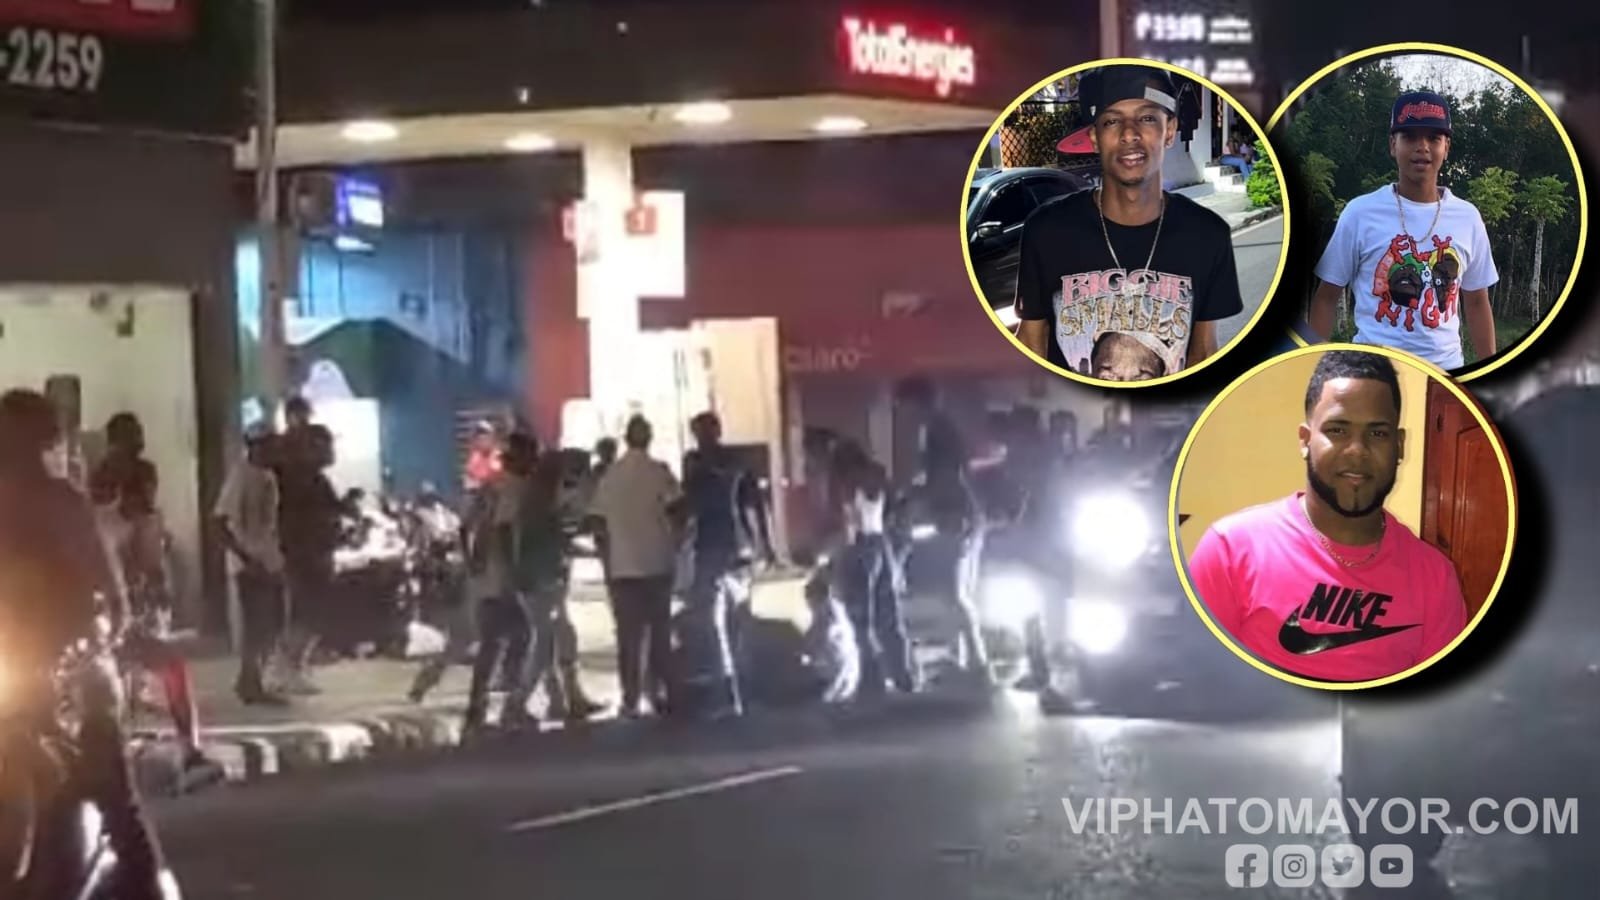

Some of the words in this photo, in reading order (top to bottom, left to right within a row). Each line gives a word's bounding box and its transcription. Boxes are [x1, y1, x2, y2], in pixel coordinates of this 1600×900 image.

[843, 16, 975, 97] TotalEnergies
[1384, 234, 1452, 263] FLY
[1061, 268, 1193, 307] BIGGIE
[1060, 293, 1191, 339] SMALLS
[1301, 582, 1393, 629] NIKE
